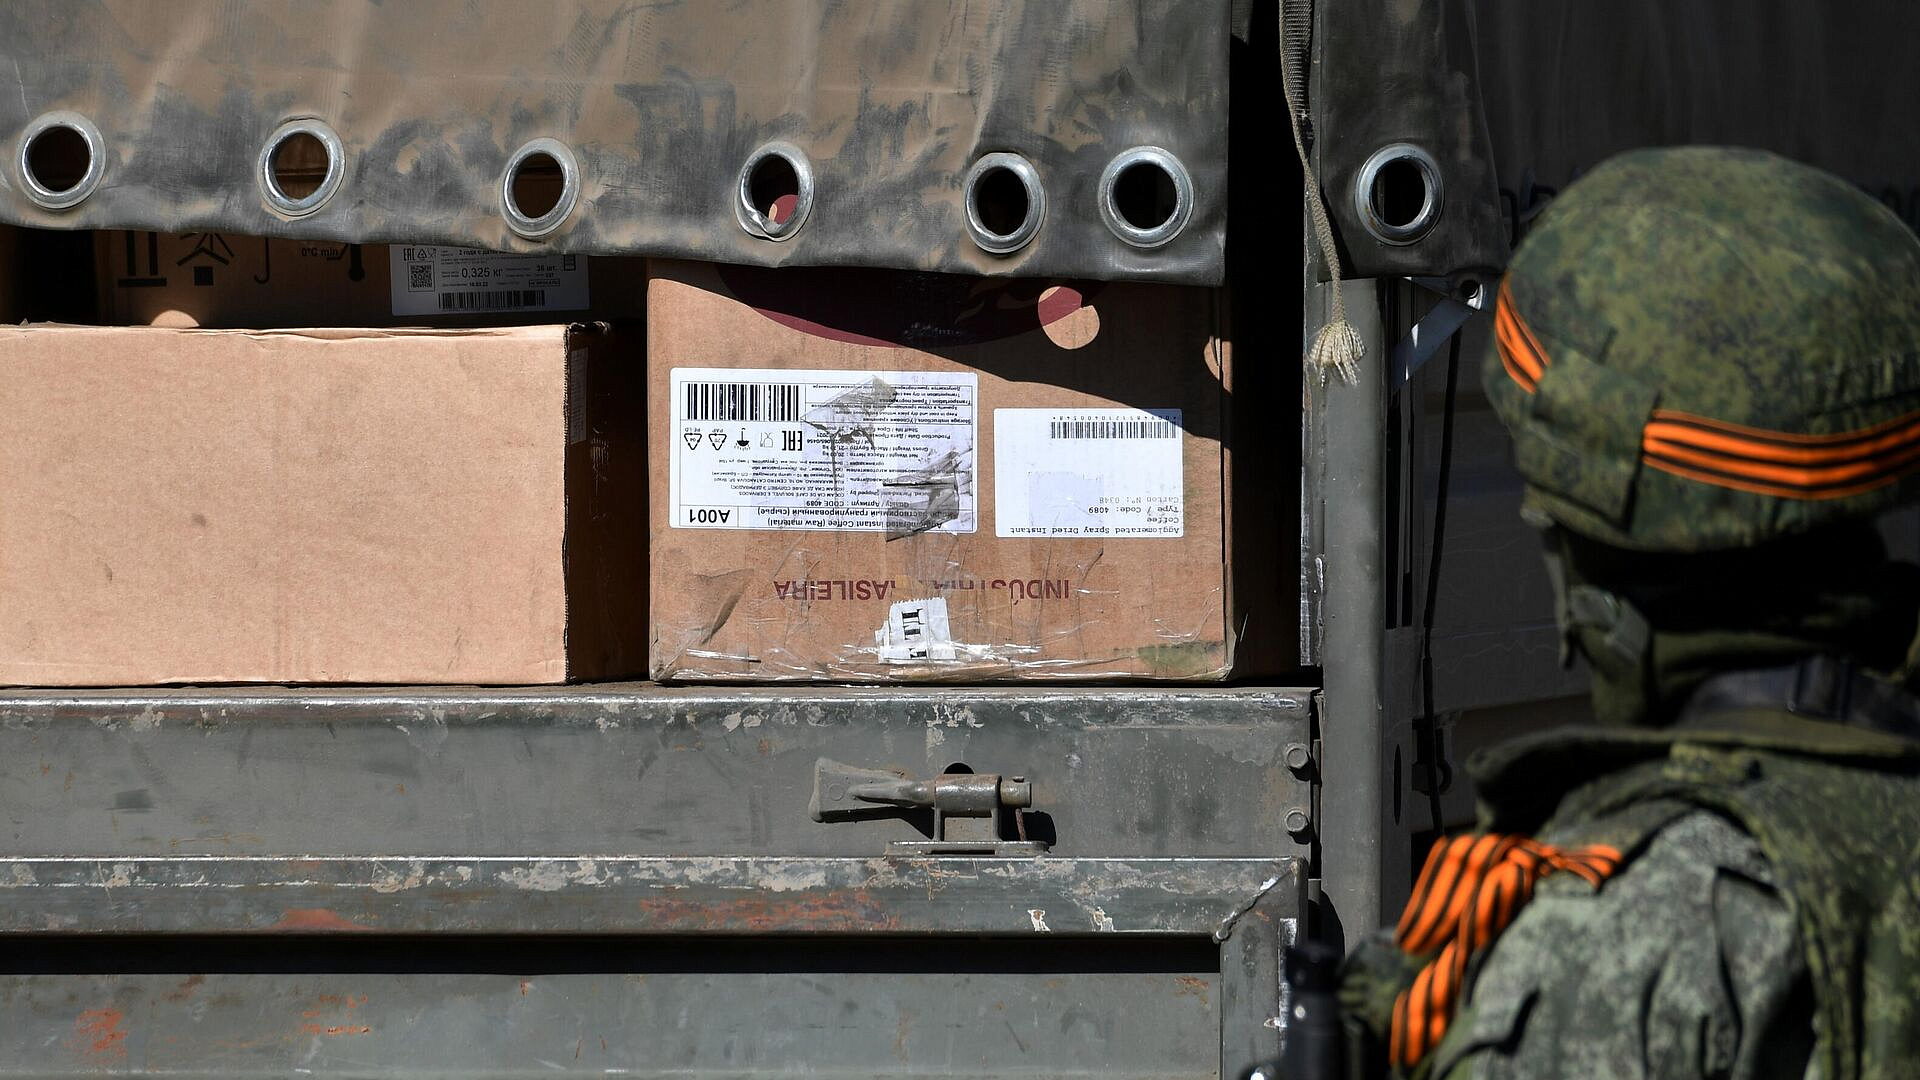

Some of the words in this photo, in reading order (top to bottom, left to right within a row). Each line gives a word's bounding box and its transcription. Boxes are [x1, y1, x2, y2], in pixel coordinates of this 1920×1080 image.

[321, 246, 338, 256] min
[461, 267, 490, 278] 0,325
[493, 268, 503, 277] кг
[1099, 496, 1120, 504] 0348
[1146, 496, 1180, 504] Carton
[757, 506, 790, 517] (сырье)
[792, 508, 868, 519] гранулированный
[1088, 506, 1110, 514] 4089
[1115, 506, 1142, 514] Code:
[1157, 505, 1180, 514] Type
[688, 508, 730, 523] A001
[767, 516, 803, 527] material)
[804, 517, 826, 527] (Raw
[827, 520, 852, 528] Coffee
[853, 520, 884, 528] Instant
[1083, 526, 1110, 534] Spray
[1115, 526, 1180, 534] Agglomerated
[772, 579, 896, 601] ASILEIRA
